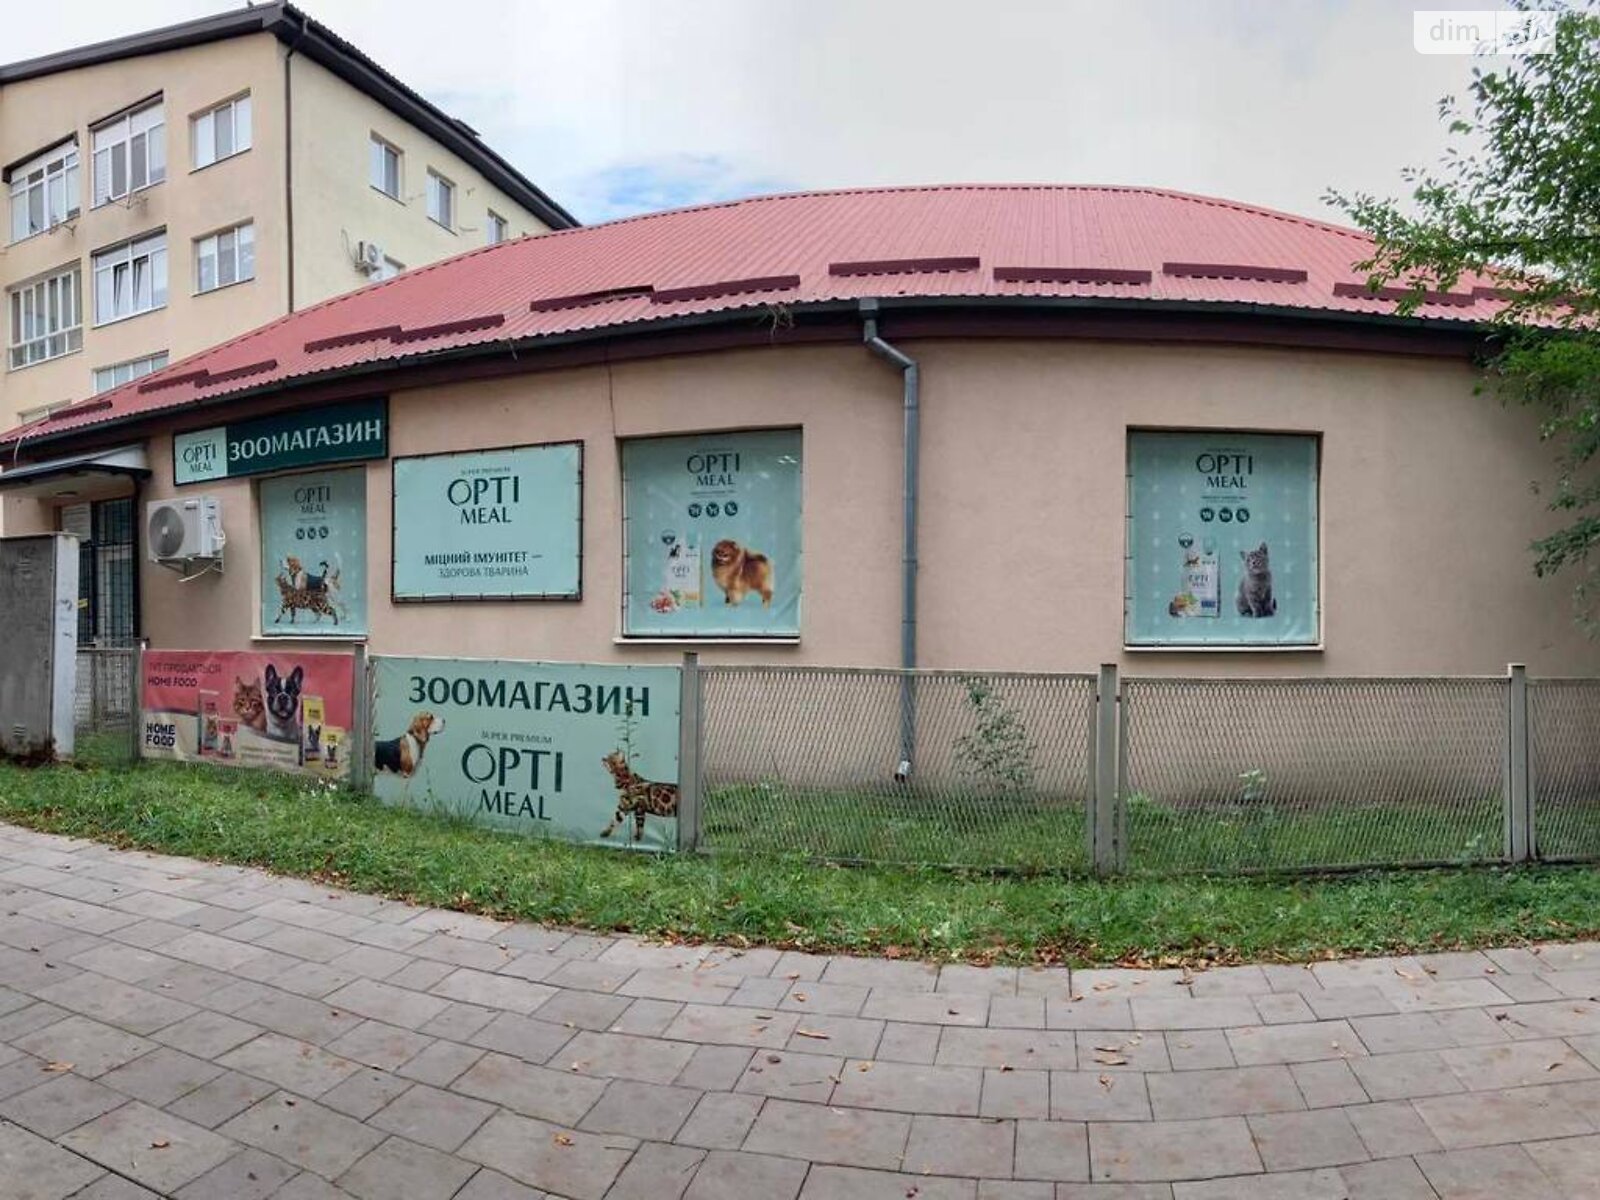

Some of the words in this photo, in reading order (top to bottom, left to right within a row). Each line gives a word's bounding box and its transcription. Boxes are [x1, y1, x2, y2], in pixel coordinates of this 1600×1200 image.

[228, 418, 381, 462] ЗООМАГАЗИН
[182, 442, 217, 464] OPTI
[686, 453, 740, 474] OPTI
[1196, 453, 1253, 475] OPTI
[696, 473, 736, 487] MEAL
[1206, 475, 1248, 488] MEAL
[294, 485, 330, 504] OPTI
[447, 475, 520, 506] OPTI
[460, 506, 512, 525] MEAL
[424, 550, 471, 566] МІЦНИЙ
[473, 551, 528, 564] ІМУНІТЕТ
[484, 565, 529, 577] ТВАРИНА
[147, 675, 172, 687] HOME
[173, 676, 198, 687] FOOD
[408, 675, 650, 717] ЗООМАГАЗИН
[146, 722, 176, 735] HOME
[145, 734, 176, 748] FOOD
[461, 743, 563, 793] OPTI
[479, 788, 552, 822] MEAL
